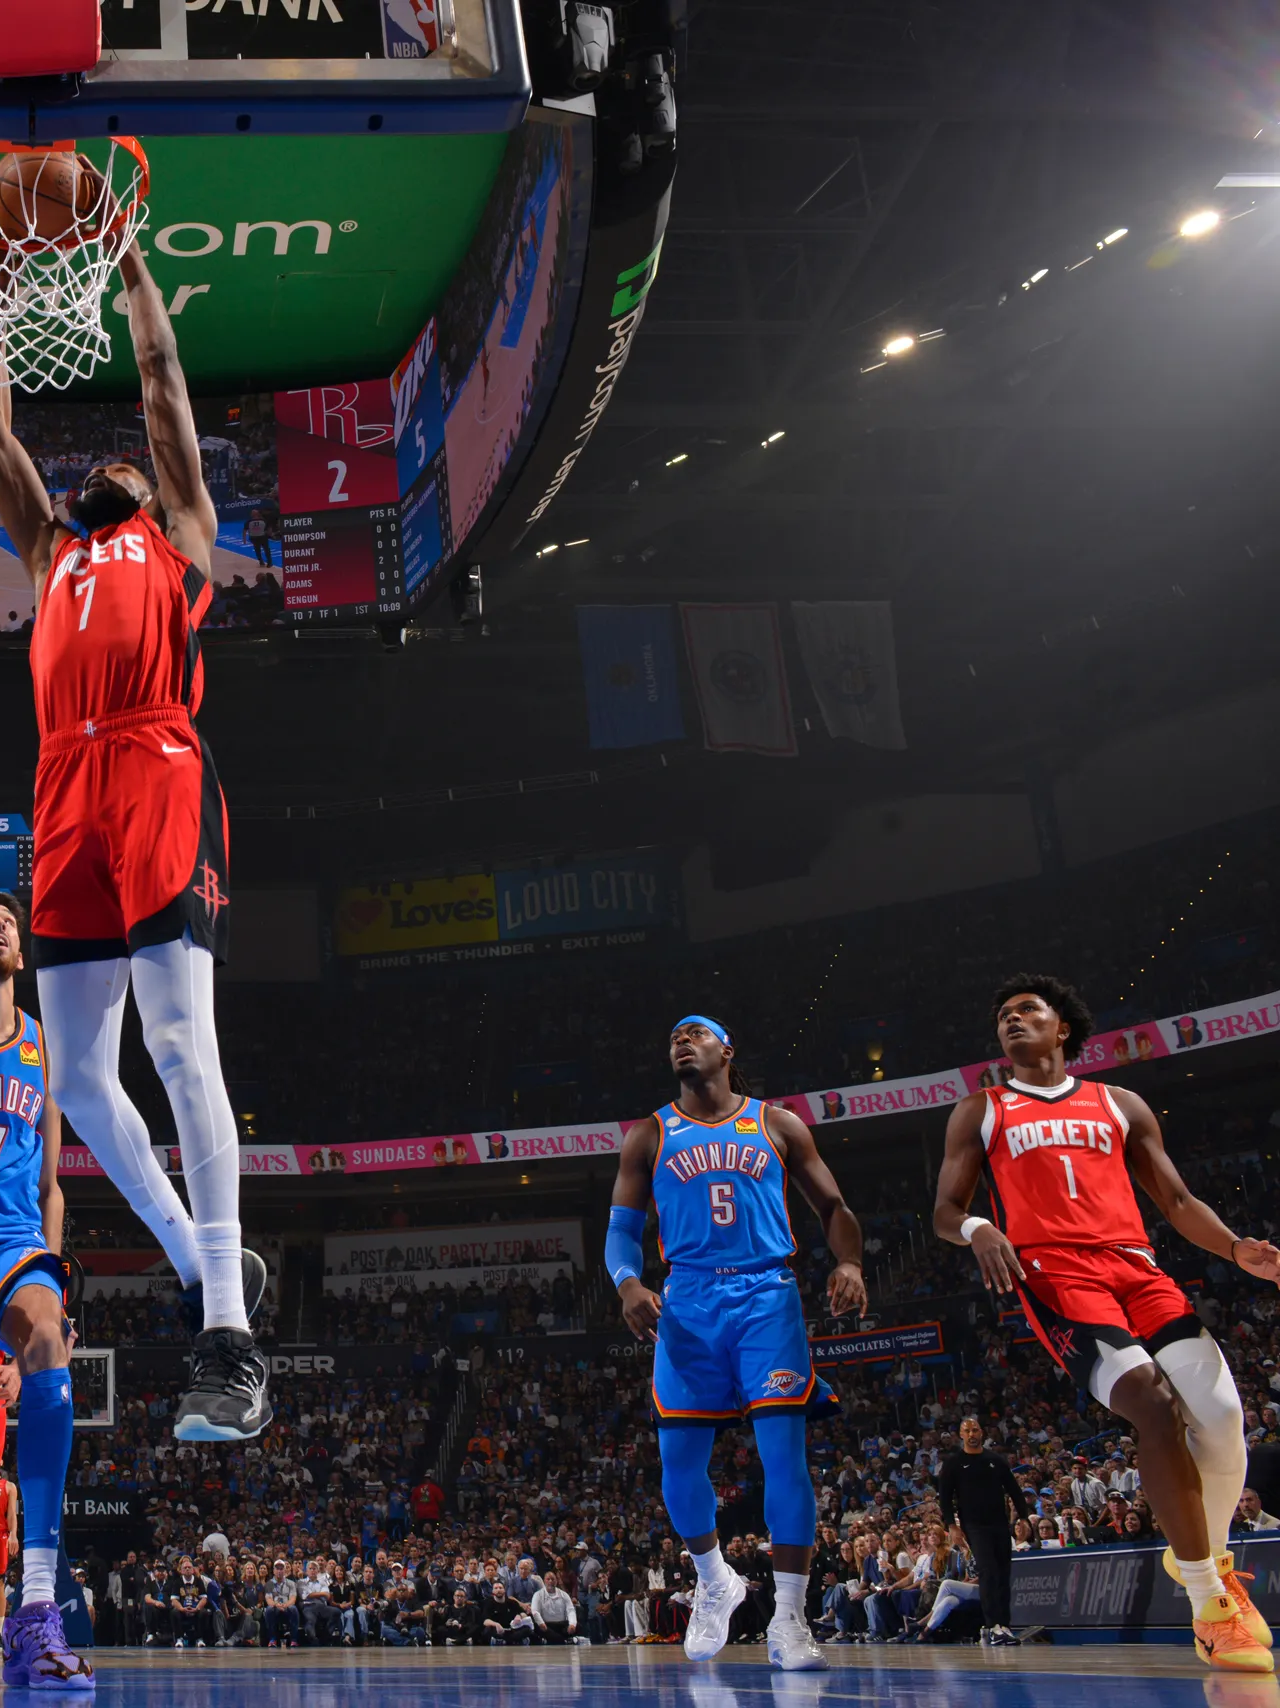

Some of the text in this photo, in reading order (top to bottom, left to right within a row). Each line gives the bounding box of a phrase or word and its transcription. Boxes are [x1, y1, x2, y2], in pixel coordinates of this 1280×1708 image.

[393, 42, 419, 58] NBA
[327, 460, 349, 503] 2
[225, 499, 261, 509] coinbase
[283, 508, 397, 528] PLAYER PTS FL
[283, 531, 326, 543] THOMPSON
[284, 548, 315, 558] DURANT
[285, 564, 309, 574] SMITH
[311, 563, 322, 572] JR.
[379, 556, 384, 564] 2
[285, 579, 312, 589] ADAMS
[74, 576, 96, 631] 7
[286, 595, 318, 605] SENGUN
[292, 611, 303, 620] TO
[307, 610, 313, 619] 7
[319, 610, 329, 618] TF
[354, 605, 368, 614] 1ST
[378, 602, 401, 613] 10:09
[504, 872, 579, 931] LOUD
[588, 869, 657, 914] CITY
[359, 931, 646, 970] BRING THE THUNDER EXIT NOW
[849, 1079, 957, 1116] BRAUM'S
[511, 1132, 616, 1158] BRAUM'S
[1005, 1119, 1112, 1160] ROCKETS
[352, 1144, 426, 1165] SUNDAES
[665, 1142, 769, 1183] THUNDER
[1059, 1155, 1078, 1199] 1
[709, 1182, 736, 1227] 5
[350, 1242, 488, 1267] POST OAK PARTY
[360, 1274, 415, 1288] POST OAK
[483, 1267, 539, 1282] POST OAK
[896, 1333, 917, 1341] Criminal
[902, 1340, 917, 1348] Family
[816, 1338, 890, 1357] & ASSOCIATES
[771, 1375, 793, 1389] OKC
[85, 1500, 130, 1515] BANK
[1012, 1576, 1060, 1590] AMERICAN
[1080, 1556, 1144, 1616] TIP-OFF
[1014, 1591, 1058, 1607] EXPRESS
